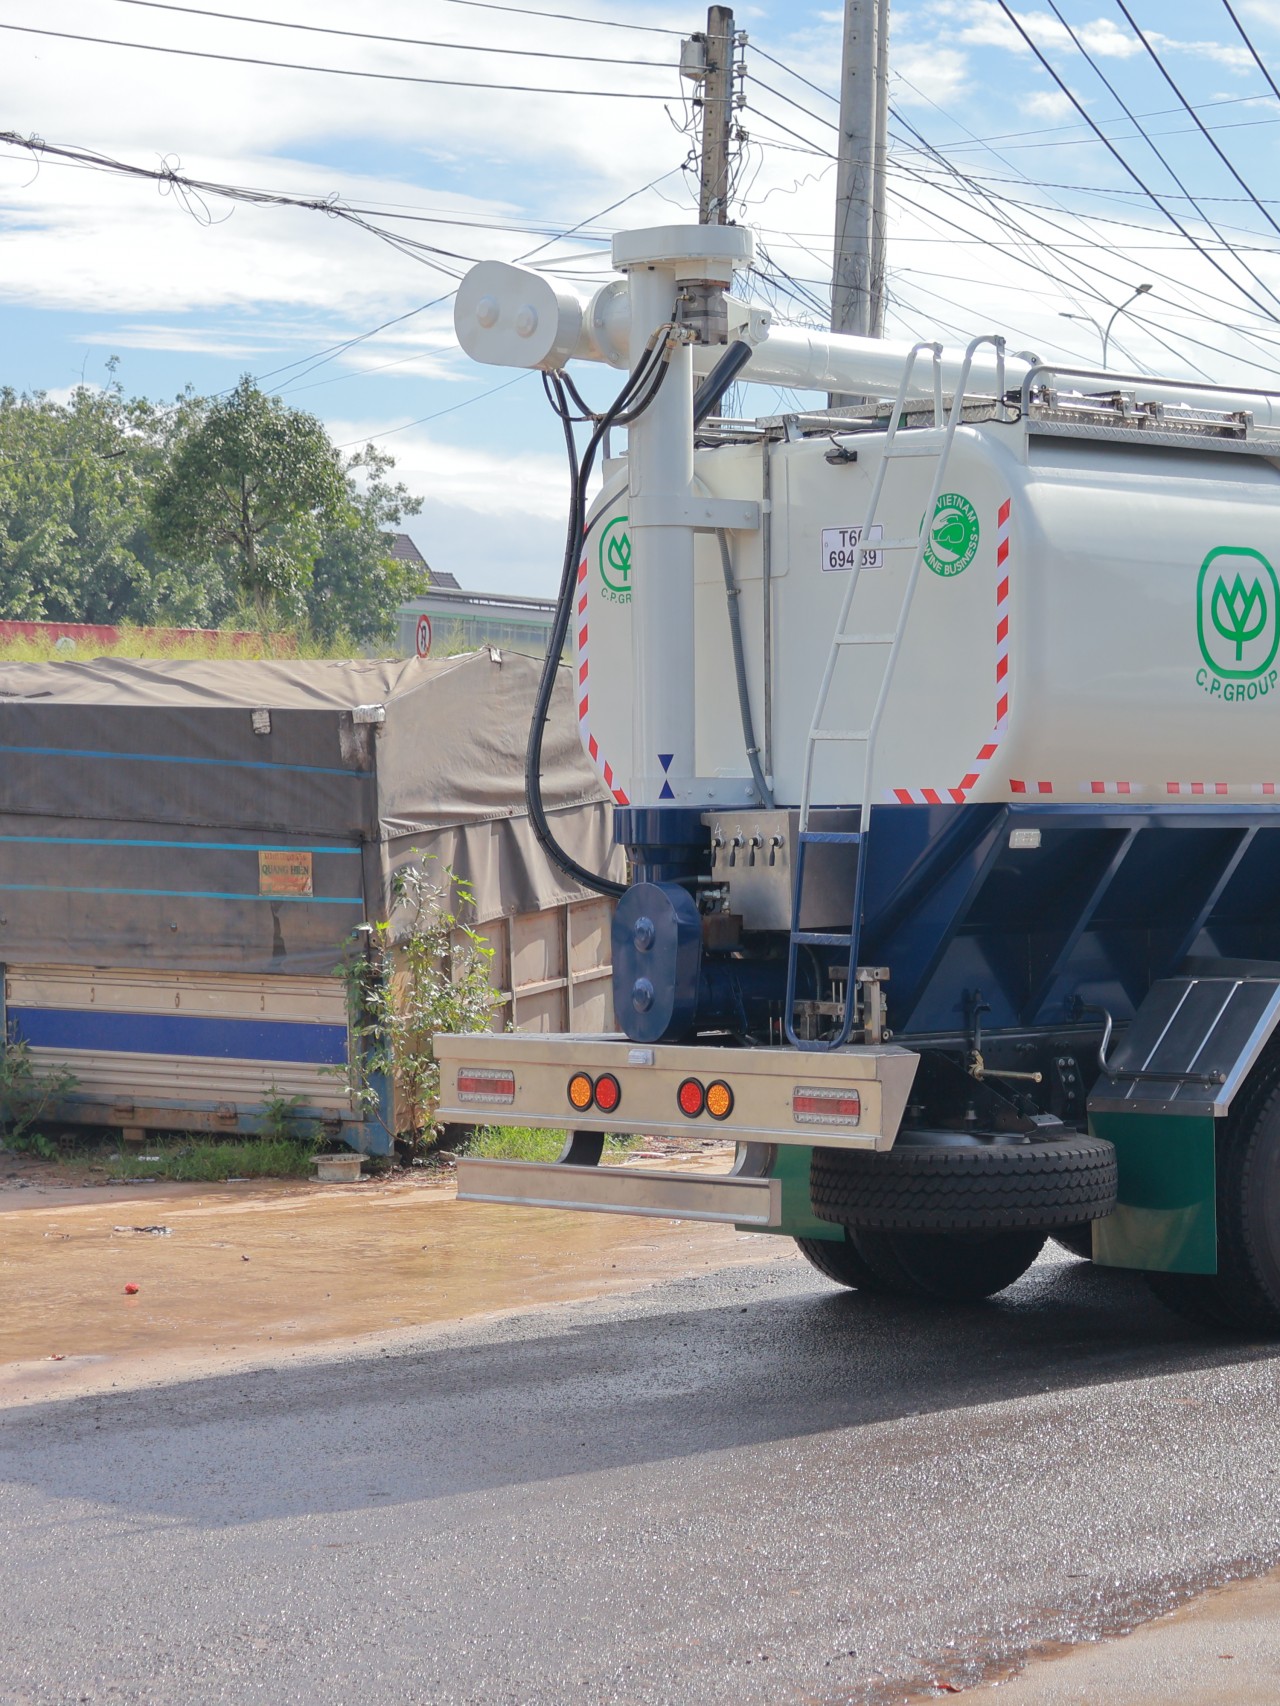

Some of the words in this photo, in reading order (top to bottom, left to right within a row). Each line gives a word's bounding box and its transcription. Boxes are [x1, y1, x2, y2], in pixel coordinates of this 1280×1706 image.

[924, 541, 943, 573] WINE
[944, 533, 978, 575] BUSINESS
[1196, 668, 1278, 702] C.P.GROUP
